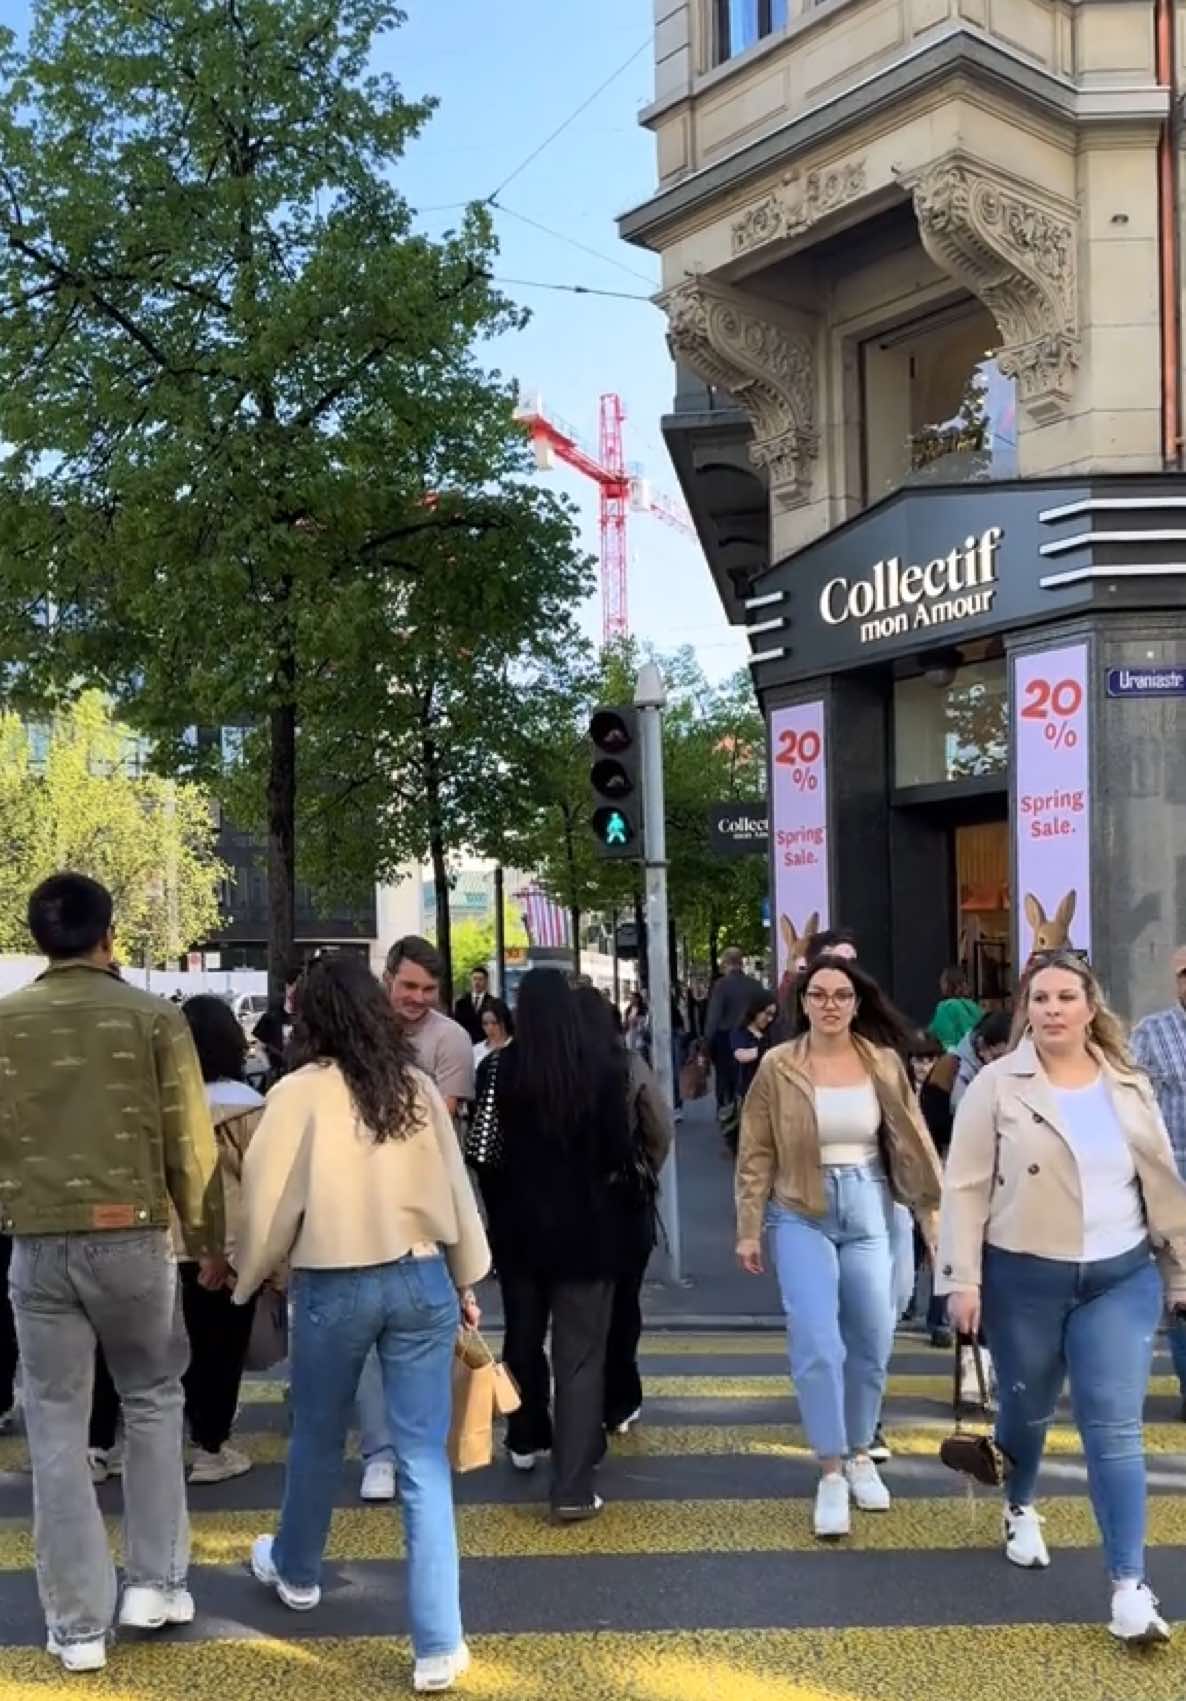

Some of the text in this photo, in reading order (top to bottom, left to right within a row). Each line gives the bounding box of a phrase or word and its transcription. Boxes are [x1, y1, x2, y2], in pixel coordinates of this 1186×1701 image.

[820, 526, 1003, 625] Collectif
[861, 591, 995, 643] mon Amour
[1021, 679, 1082, 717] 20
[775, 729, 820, 765] 20
[1044, 721, 1077, 749] %
[792, 767, 818, 791] %
